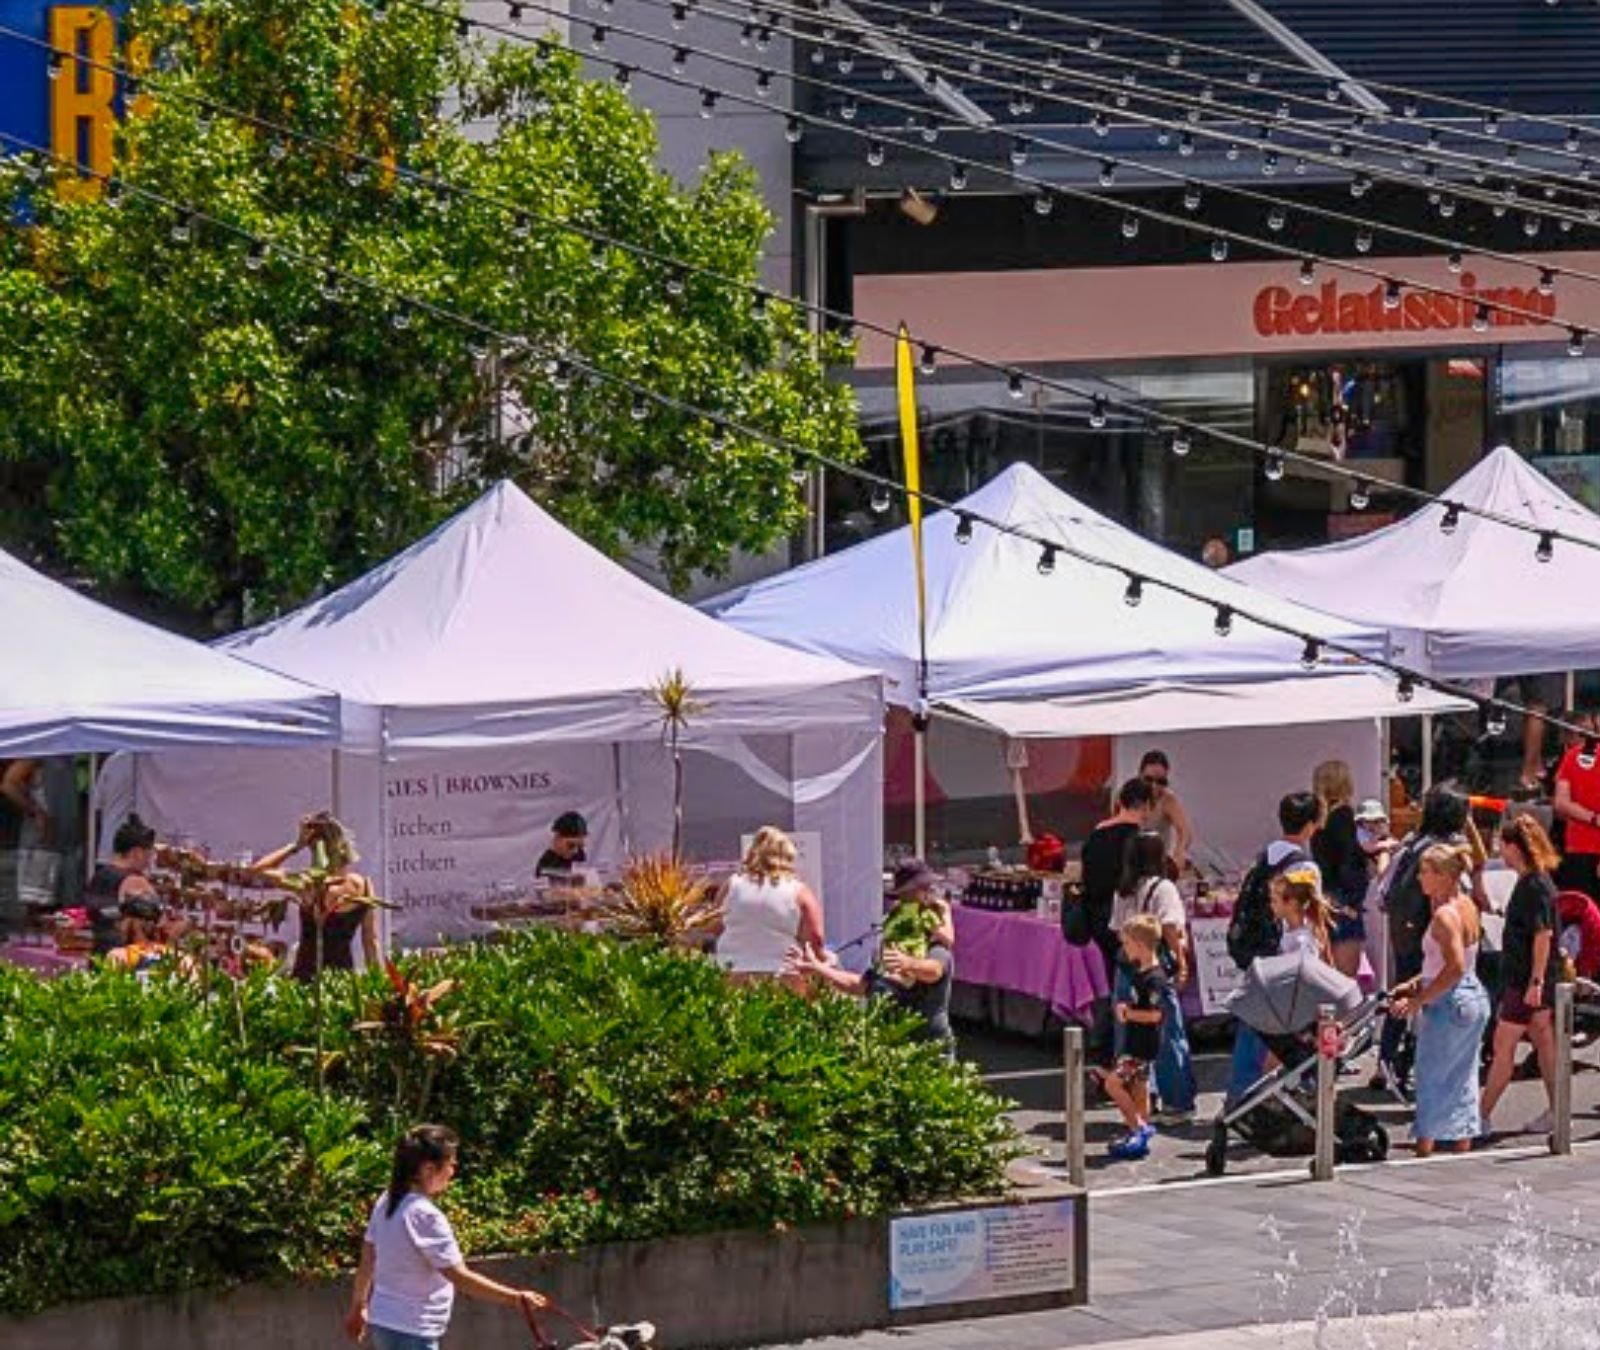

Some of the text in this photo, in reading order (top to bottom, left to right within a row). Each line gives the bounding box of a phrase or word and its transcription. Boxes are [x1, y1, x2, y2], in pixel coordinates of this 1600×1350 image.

[1252, 271, 1556, 337] Gelatissimo
[446, 772, 551, 795] BROWNIES
[391, 813, 452, 837] itchen
[929, 1222, 952, 1237] FUN
[900, 1242, 925, 1256] PLAY
